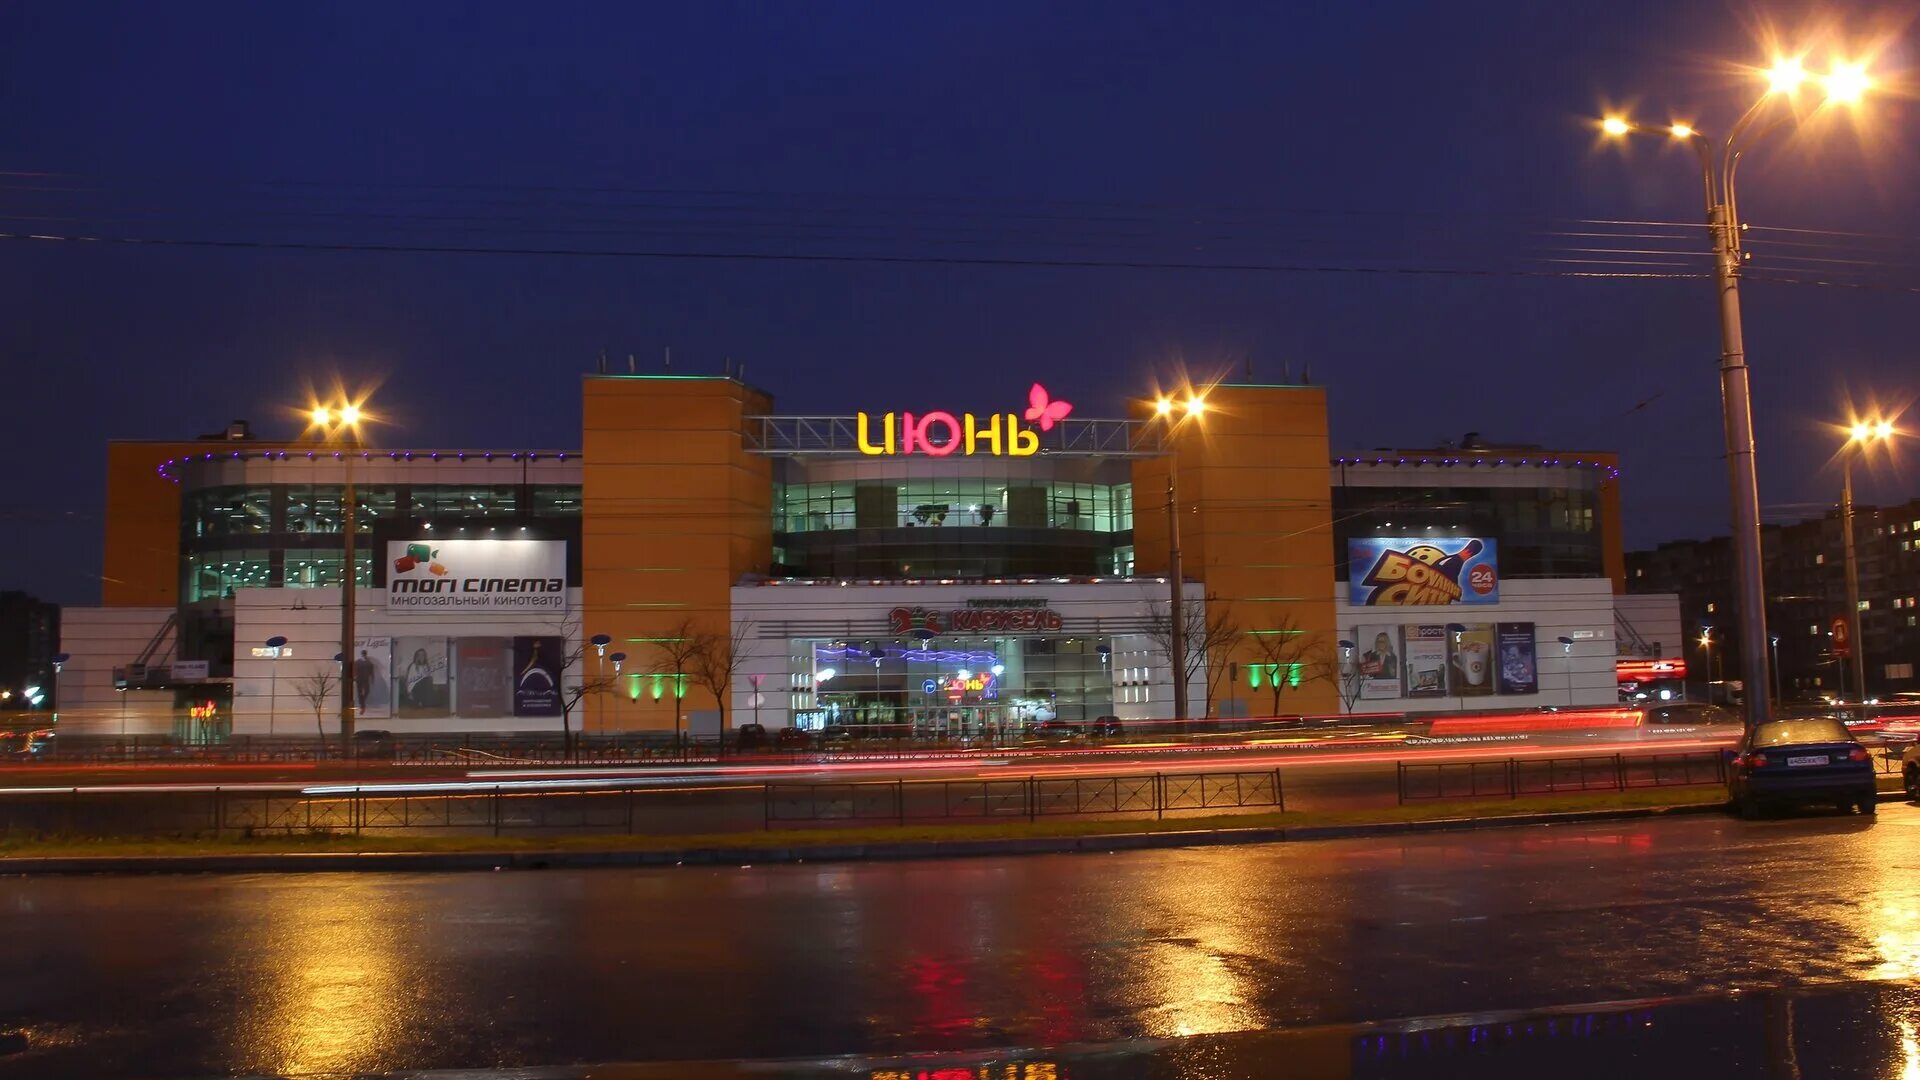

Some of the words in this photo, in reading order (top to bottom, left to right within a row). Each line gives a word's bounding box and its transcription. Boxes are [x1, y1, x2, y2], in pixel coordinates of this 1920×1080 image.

[1471, 571, 1493, 583] 24
[392, 578, 457, 593] mori
[463, 578, 563, 593] cinema
[391, 594, 489, 606] многозальный
[494, 595, 563, 608] кинотеатр
[952, 609, 1063, 631] КАРУСЕЛЬ
